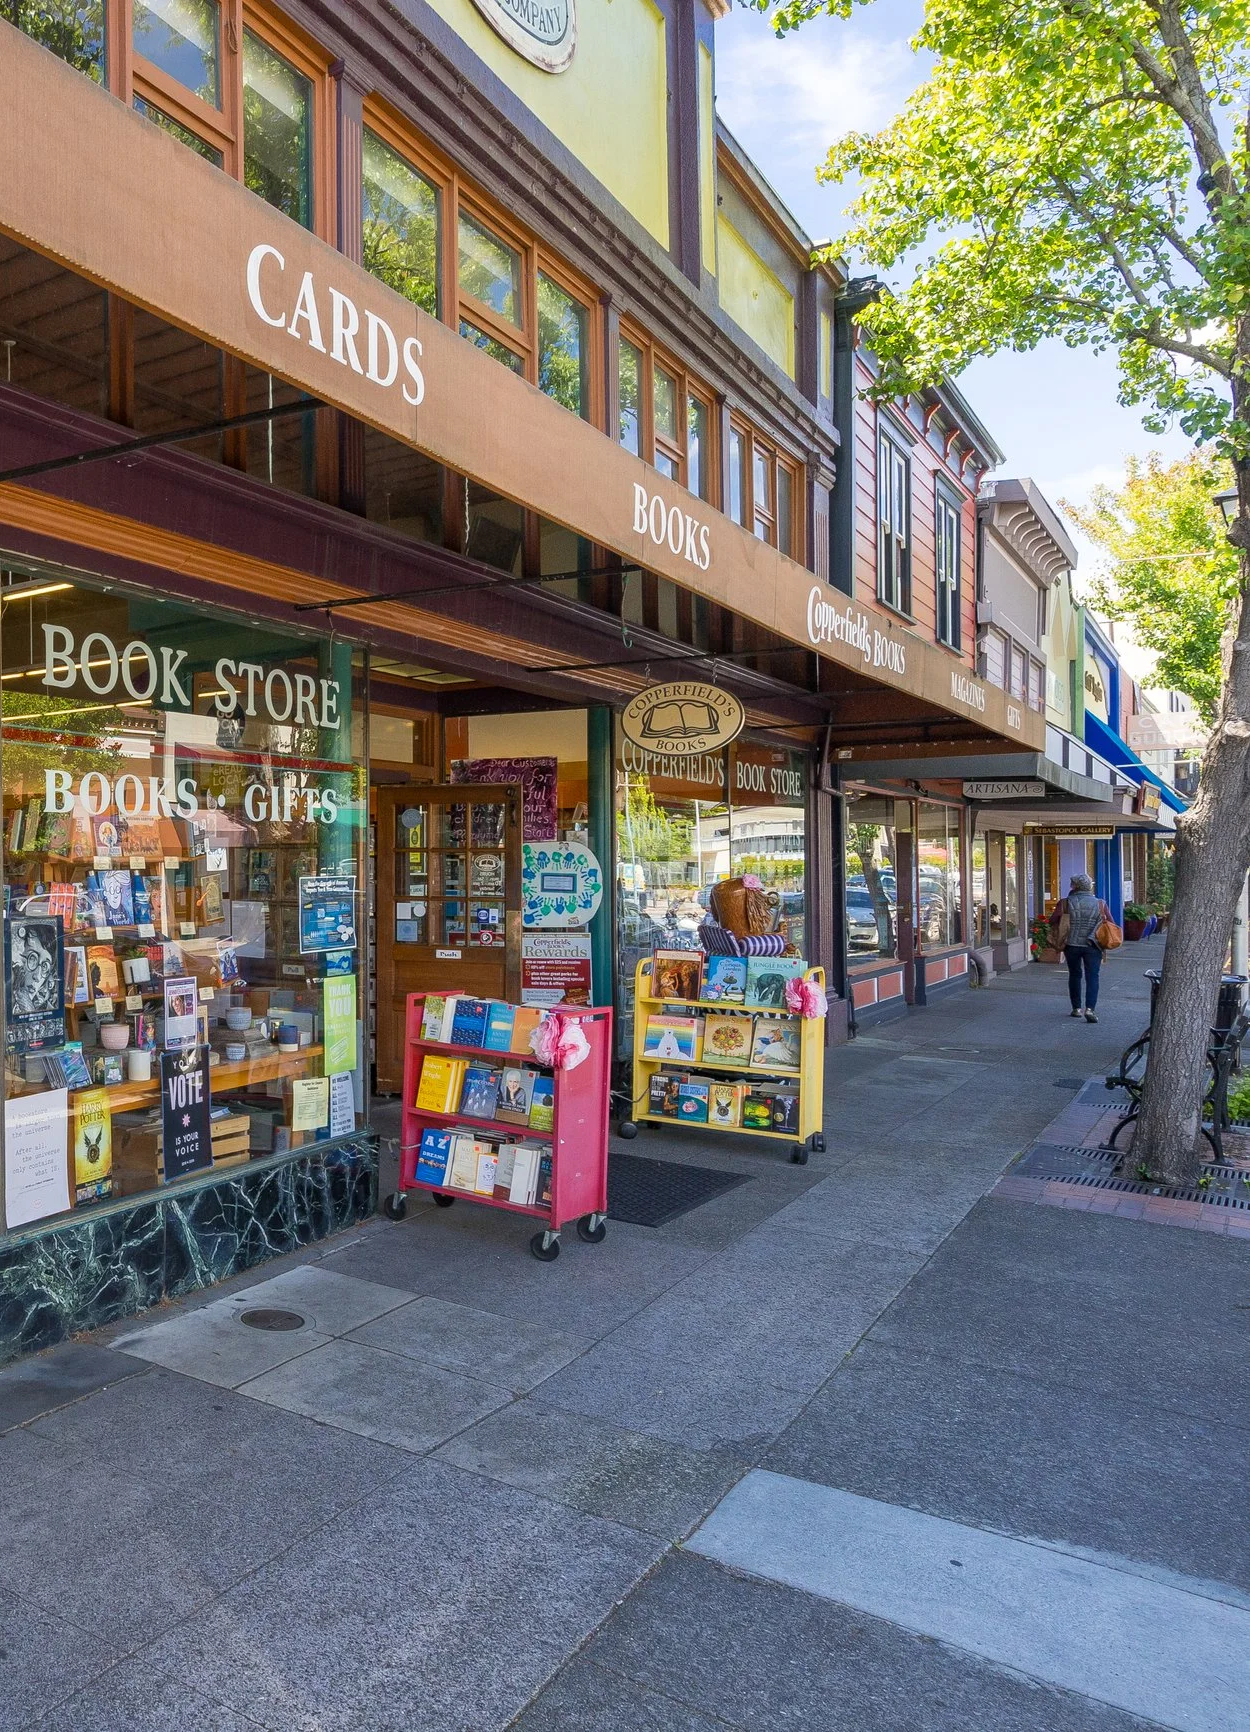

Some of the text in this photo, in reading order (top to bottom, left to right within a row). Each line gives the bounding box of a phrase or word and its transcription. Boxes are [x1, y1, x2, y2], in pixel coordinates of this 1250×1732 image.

[246, 244, 425, 406] CARDS
[633, 482, 710, 571] BOOKS
[807, 586, 906, 674] Copperfield's BOOKS
[41, 623, 341, 730] BOOK STORE
[950, 672, 986, 712] MAGAZINES
[628, 684, 736, 719] COPPERFIELD'S
[1007, 704, 1021, 729] GIFTS
[655, 738, 707, 752] BOOKS
[525, 768, 553, 786] for
[736, 761, 767, 792] BOOK
[770, 767, 801, 797] STORE
[44, 769, 338, 825] BOOKS GIFTS
[965, 784, 1029, 795] ARTISANA
[1080, 826, 1112, 834] GALLERY
[533, 938, 571, 947] Copperfield's
[525, 945, 588, 958] Rewards
[329, 984, 352, 997] THANK
[329, 997, 352, 1018] YOU
[424, 1062, 442, 1071] Robert
[168, 1070, 203, 1111] VOTE
[81, 1100, 104, 1113] HARRY
[80, 1110, 106, 1126] POTTER
[12, 1124, 54, 1139] the universe.
[175, 1131, 199, 1146] IS YOUR
[175, 1142, 200, 1157] VOICE
[425, 1135, 447, 1150] A Z
[15, 1146, 33, 1156] After
[22, 1148, 61, 1163] the universe
[422, 1150, 446, 1161] DREAMS
[12, 1158, 54, 1175] only contains
[35, 1168, 49, 1177] what
